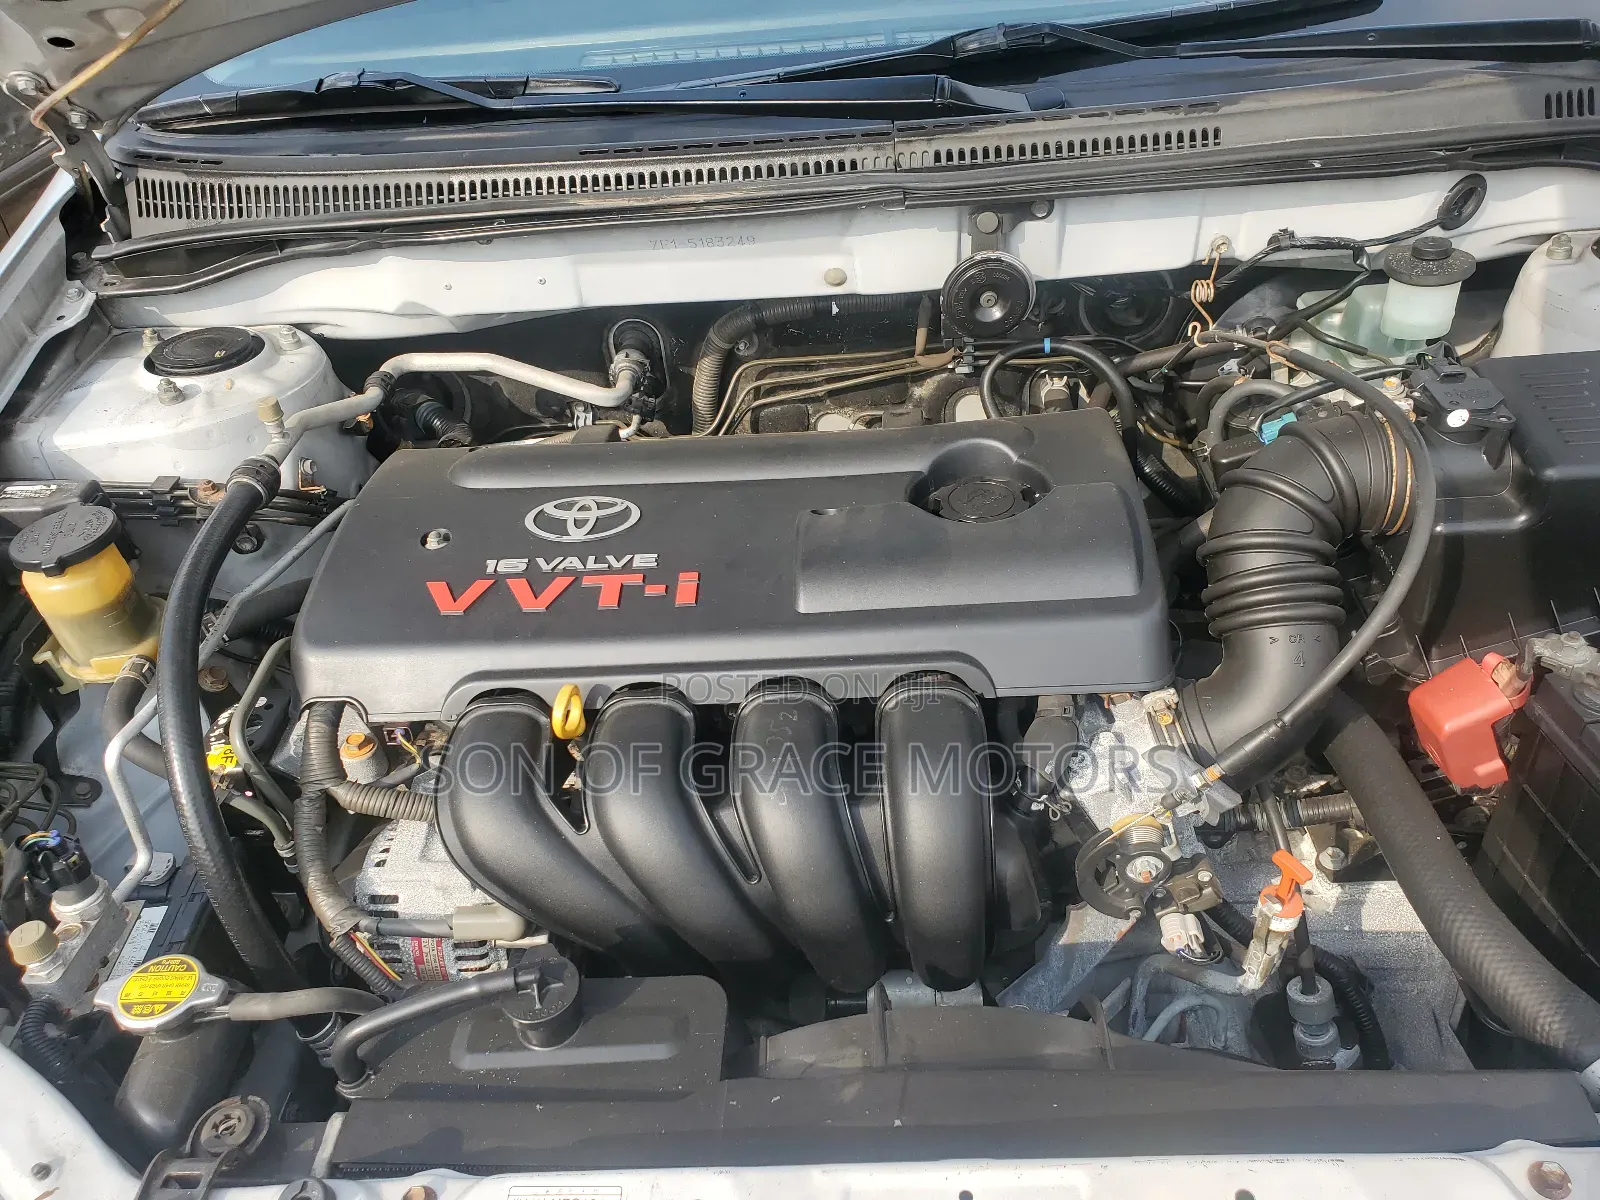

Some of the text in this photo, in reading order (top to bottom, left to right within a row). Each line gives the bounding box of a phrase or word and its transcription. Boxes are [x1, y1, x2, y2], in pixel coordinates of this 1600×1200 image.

[486, 554, 659, 574] 16 VALVE
[426, 572, 699, 615] VVT-i
[1293, 650, 1305, 668] 4
[148, 964, 187, 973] CAUTION
